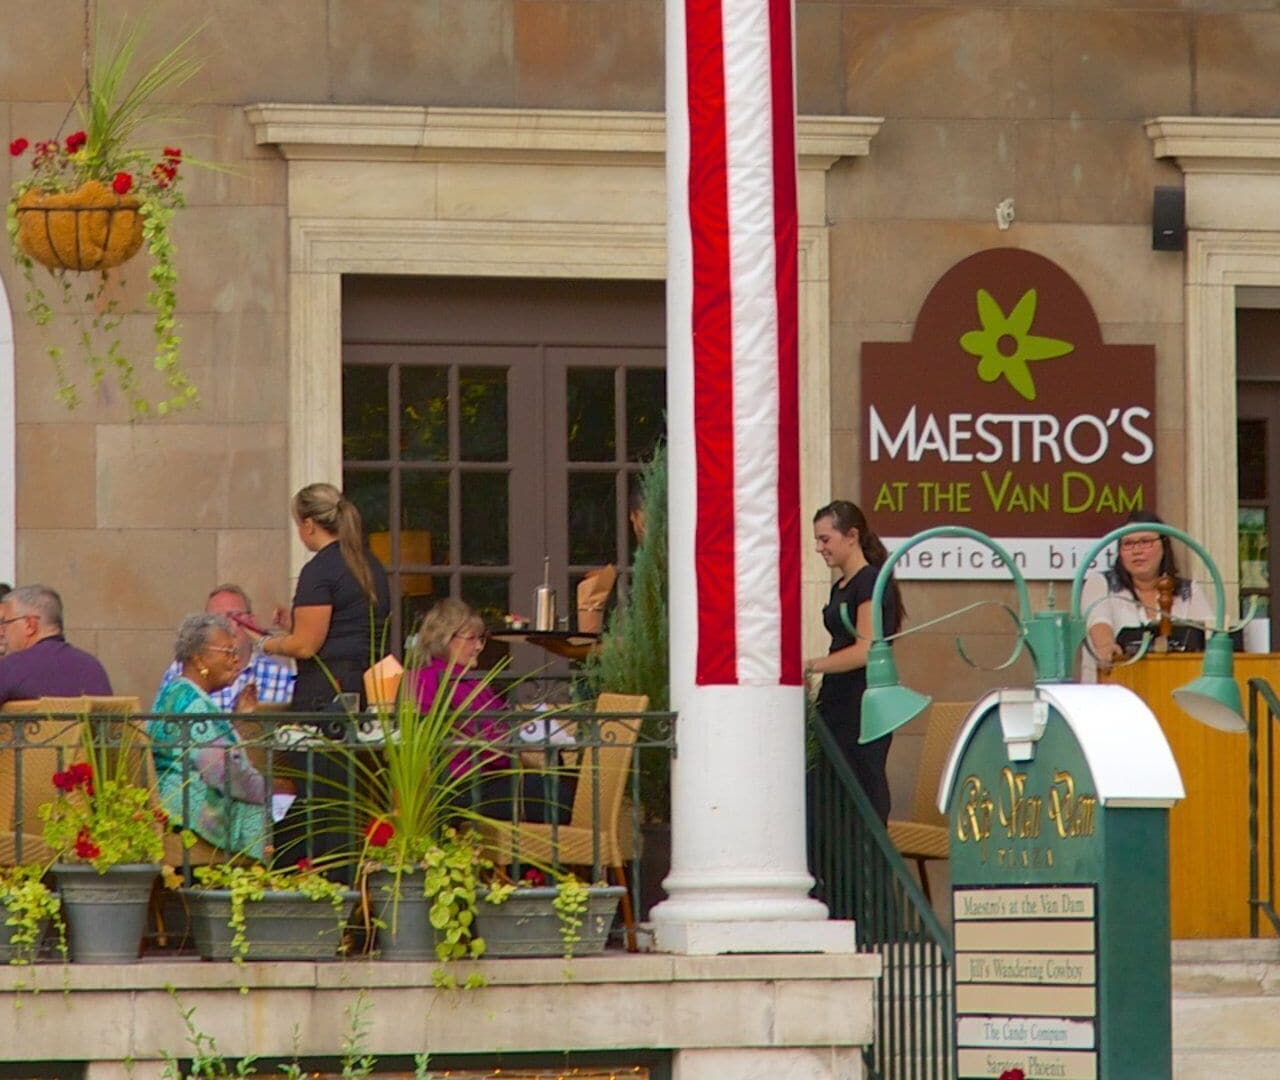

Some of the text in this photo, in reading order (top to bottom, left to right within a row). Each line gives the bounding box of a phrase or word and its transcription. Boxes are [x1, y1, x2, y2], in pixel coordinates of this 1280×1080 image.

[869, 404, 1155, 465] MAESTRO'S
[873, 482, 909, 513] AT
[918, 482, 972, 513] THE
[980, 470, 1050, 514] VAN
[888, 546, 1027, 569] merican
[957, 767, 1096, 862] Rip Van Dam
[963, 893, 1085, 915] Maestro's at the Van Dam
[993, 959, 1043, 980] Wandering
[1046, 959, 1083, 980] Cowboy
[983, 1022, 1068, 1045] The Candy Company
